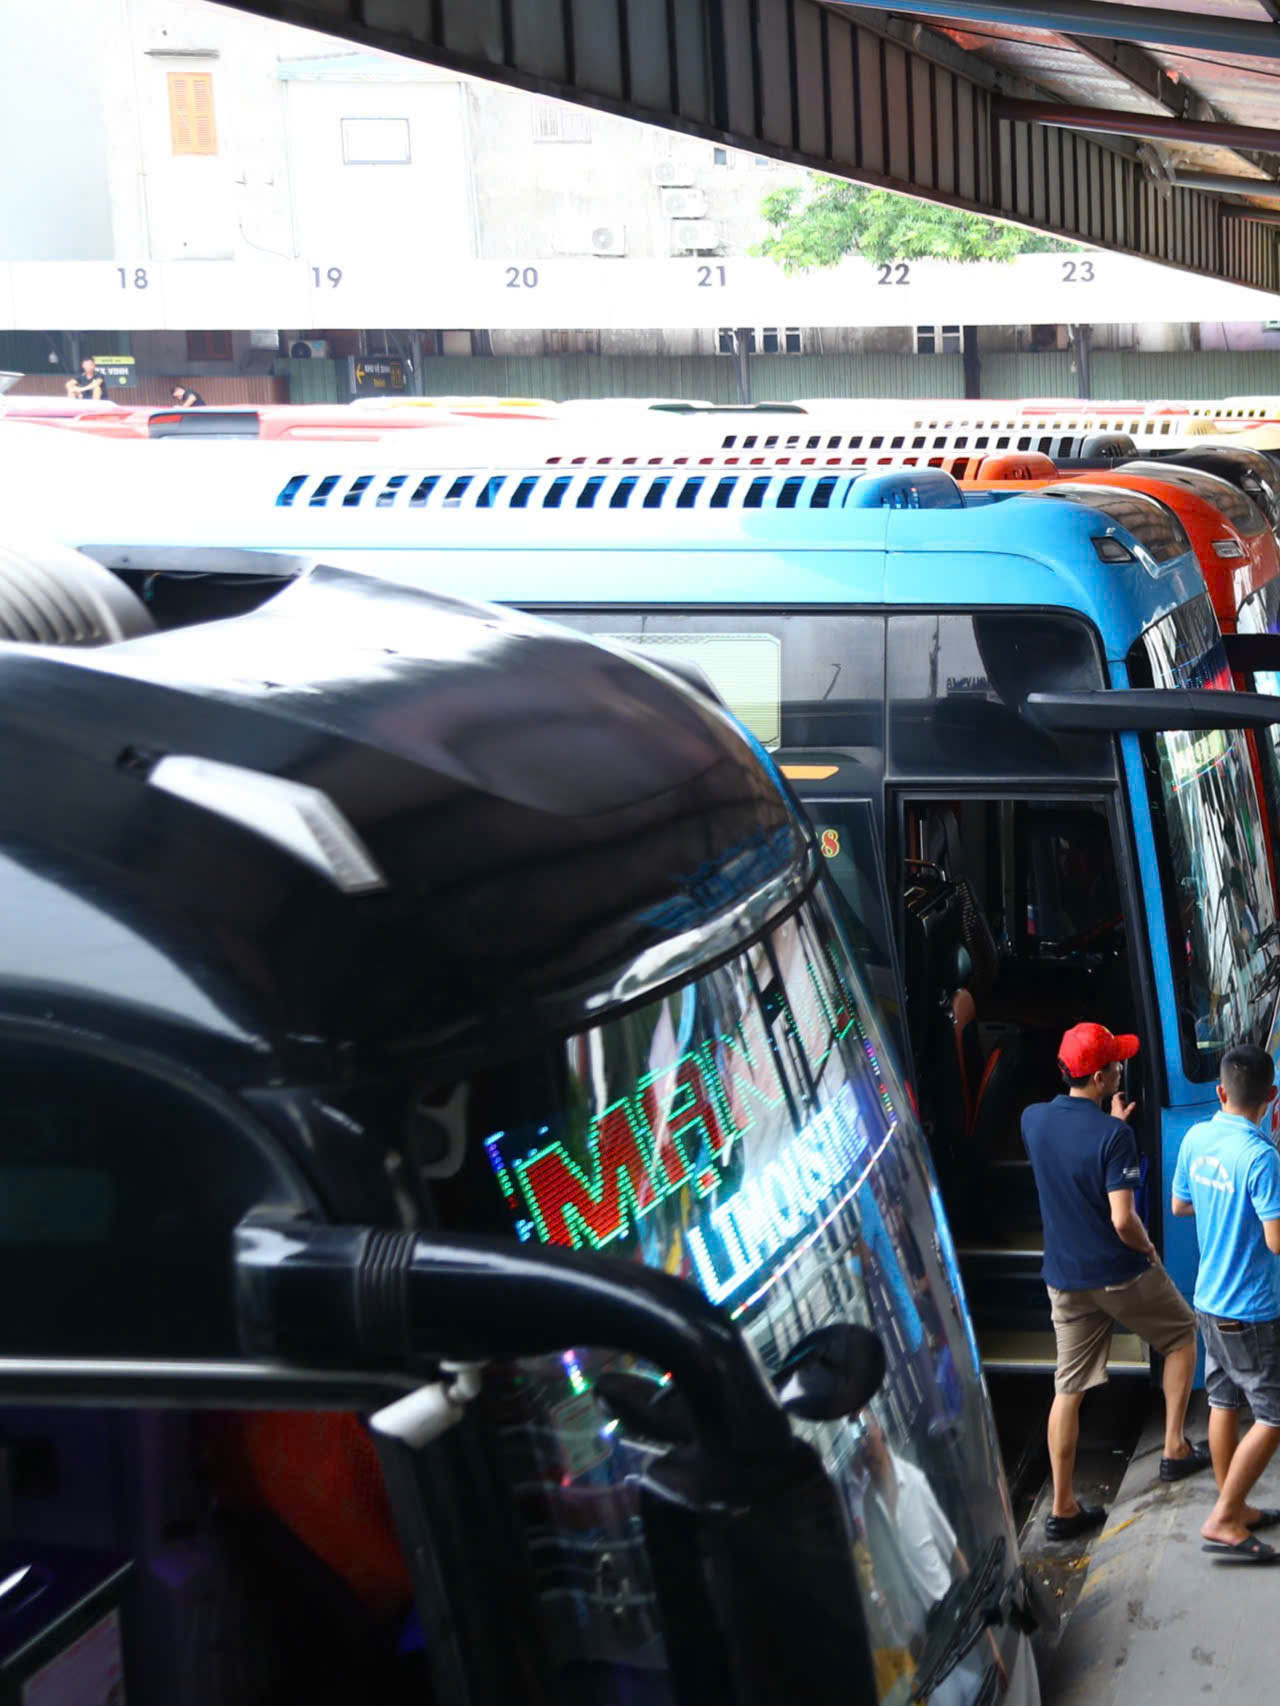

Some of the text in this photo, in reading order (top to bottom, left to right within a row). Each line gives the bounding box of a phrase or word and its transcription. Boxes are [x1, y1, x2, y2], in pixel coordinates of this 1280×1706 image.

[117, 268, 148, 289] 18
[312, 267, 342, 288] 19
[505, 267, 539, 288] 20
[697, 266, 726, 287] 21
[878, 264, 910, 285] 22
[1062, 261, 1095, 282] 23
[815, 829, 840, 858] 8
